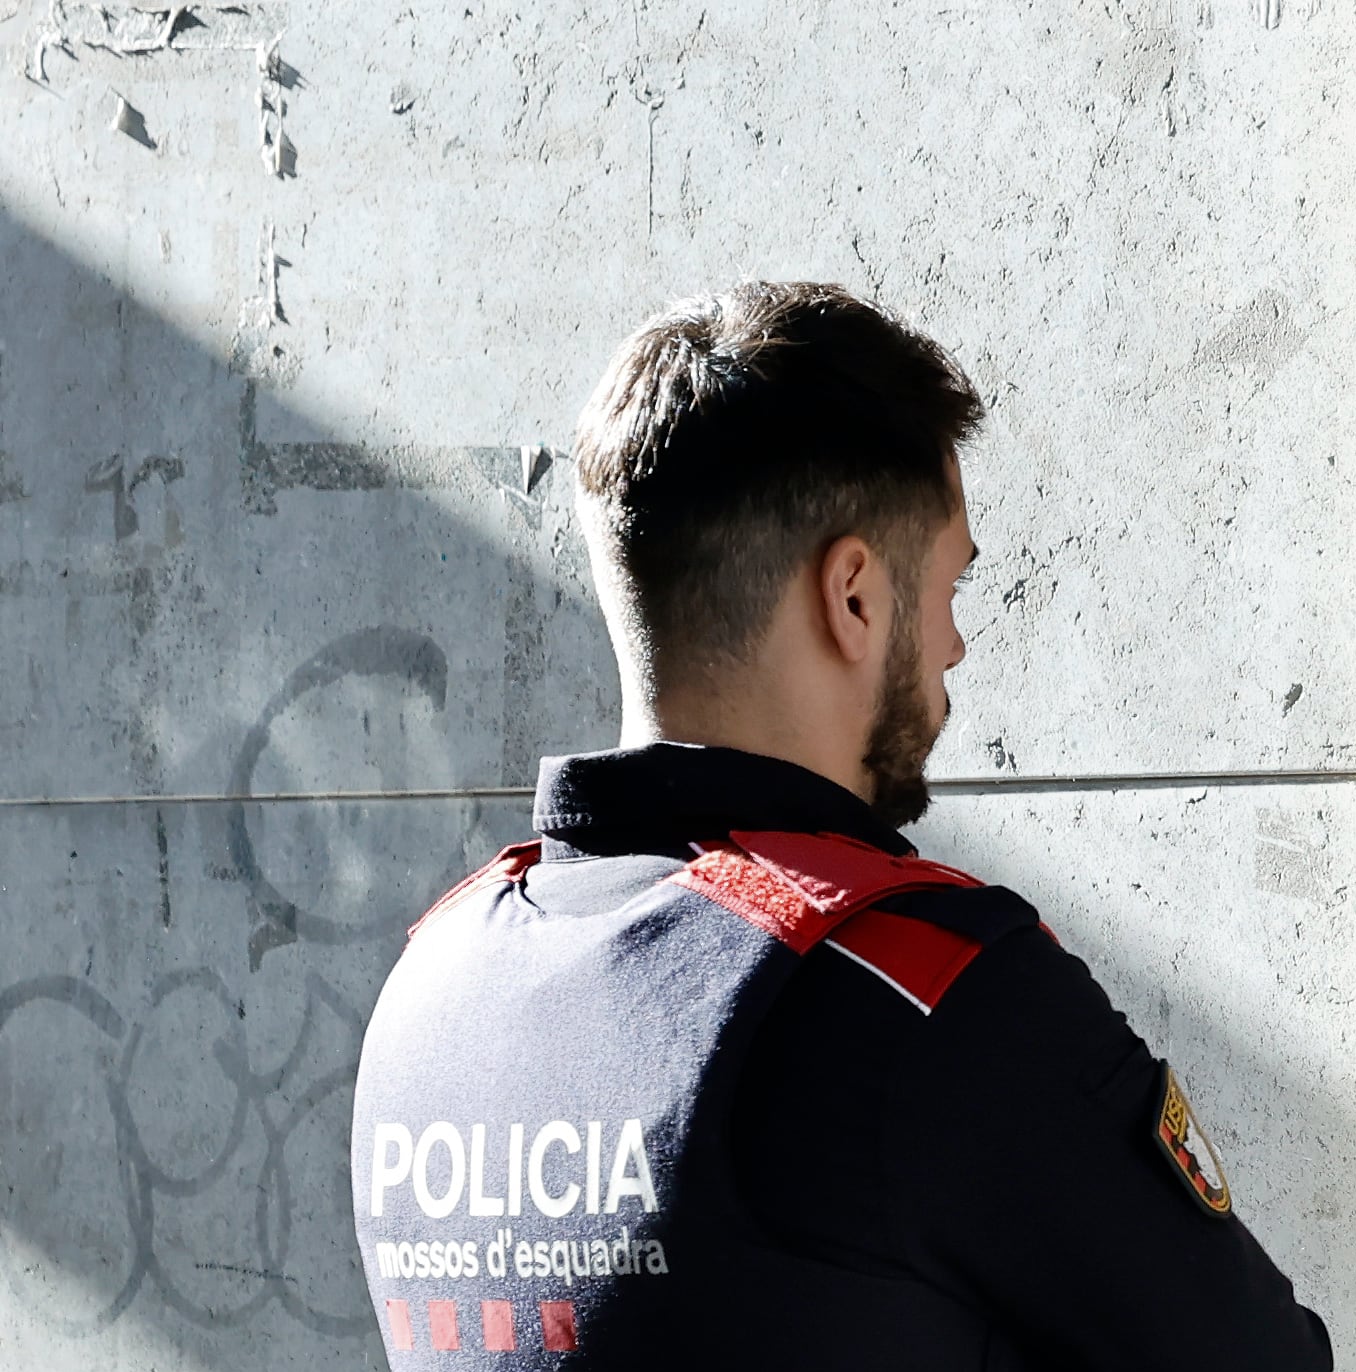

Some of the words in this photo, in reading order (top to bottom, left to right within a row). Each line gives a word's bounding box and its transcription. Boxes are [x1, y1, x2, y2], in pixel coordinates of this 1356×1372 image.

[370, 1118, 659, 1219] POLICIA
[375, 1240, 480, 1279] mossos
[486, 1226, 669, 1288] d'esquadra
